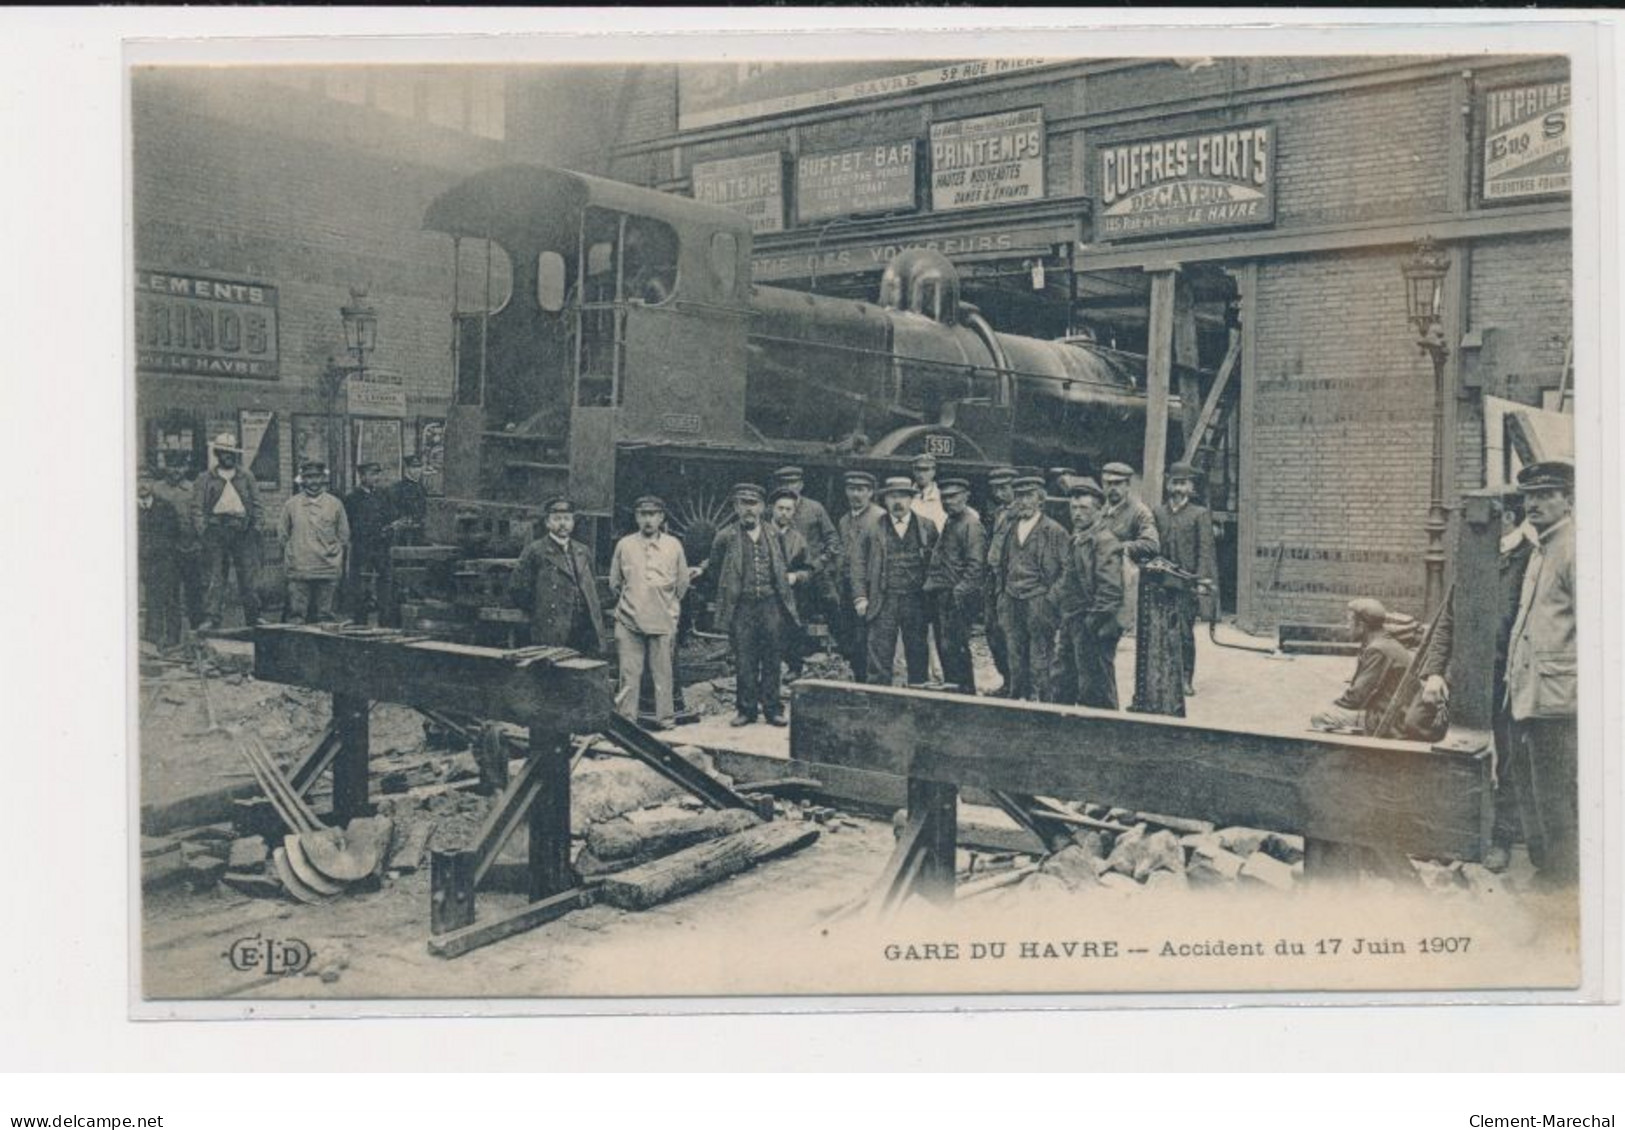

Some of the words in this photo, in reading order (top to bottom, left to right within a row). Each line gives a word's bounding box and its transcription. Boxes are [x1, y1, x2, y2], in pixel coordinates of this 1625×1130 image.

[963, 62, 988, 78] RUE
[933, 129, 1041, 170] PRINTEMPS
[1102, 127, 1268, 204] COFFRES-FORTS
[694, 172, 779, 202] PRINTEMPS
[1188, 209, 1202, 222] LE
[1208, 201, 1259, 221] HAVRE
